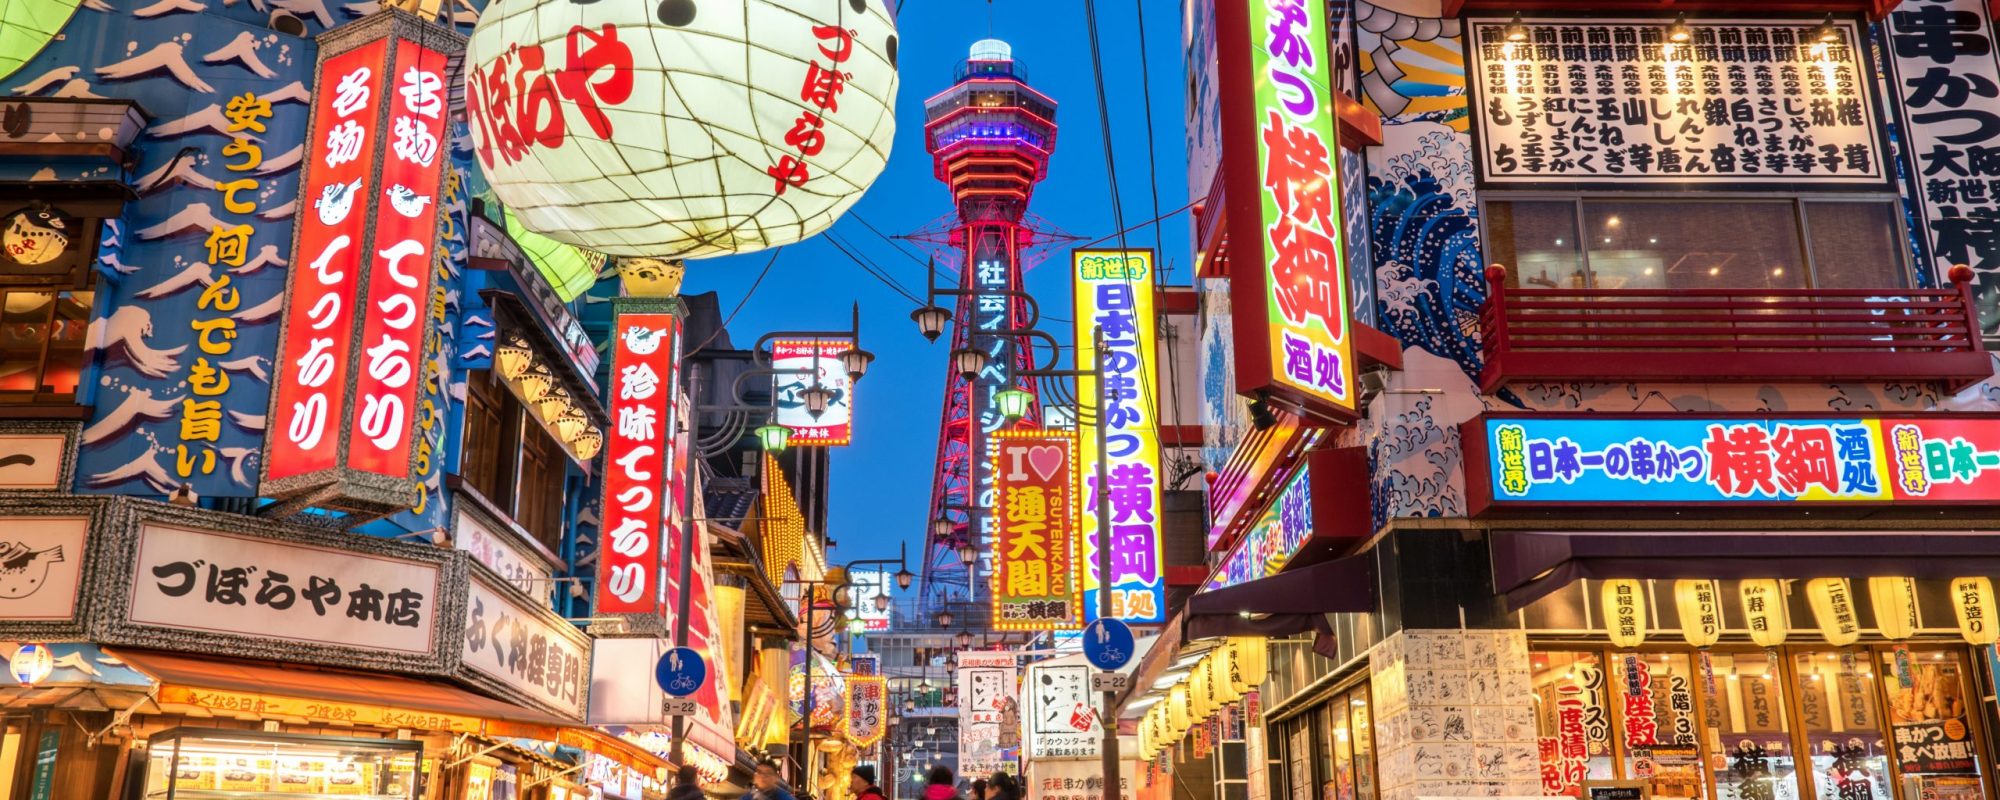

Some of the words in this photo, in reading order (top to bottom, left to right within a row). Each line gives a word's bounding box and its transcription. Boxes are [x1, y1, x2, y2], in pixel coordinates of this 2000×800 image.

[1481, 27, 1507, 61] 前頭
[1508, 27, 1534, 61] 頭
[1534, 27, 1560, 61] 前頭
[1560, 27, 1587, 62] 前頭
[1587, 27, 1614, 62] 前頭
[1614, 27, 1641, 62] 前頭
[1641, 27, 1667, 62] 前頭
[1667, 28, 1693, 62] 頭
[1693, 27, 1719, 62] 前頭
[1719, 27, 1746, 62] 前頭
[1745, 27, 1773, 62] 前頭
[1771, 27, 1799, 62] 前頭
[1568, 65, 1588, 94] 大地の幸
[1594, 65, 1615, 94] 大地の幸
[1621, 65, 1642, 94] 大地の幸
[1648, 65, 1667, 95] 大地の幸
[1675, 65, 1695, 95] 大地の幸
[1700, 65, 1722, 95] 大地の幸
[1727, 65, 1748, 95] 大地の幸
[1754, 65, 1775, 95] 大地の幸
[1780, 65, 1802, 95] 大地の幸
[1807, 65, 1828, 95] 大地の幸
[1834, 65, 1855, 95] 大地の幸
[1892, 5, 2000, 145] 串かつ
[326, 66, 371, 168] 名物
[392, 66, 443, 167] 名物
[768, 25, 858, 195] づぼらや
[1489, 97, 1517, 172] もち
[1516, 97, 1547, 172] うずら玉子
[1542, 97, 1575, 172] 紅しょうが
[1569, 99, 1598, 173] にんにく
[1596, 98, 1627, 173] 玉ねぎ
[1623, 98, 1654, 173] 山芋
[1650, 98, 1682, 172] しし唐
[1677, 98, 1710, 173] れんこん
[1702, 98, 1735, 172] 銀杏
[1731, 98, 1762, 172] 白ねぎ
[1758, 98, 1790, 172] さつま芋
[1784, 98, 1817, 172] じゃが芋
[1810, 98, 1843, 172] 茄子
[1837, 98, 1870, 173] 椎茸
[1920, 145, 2000, 177] 大阪
[1264, 112, 1343, 340] 横綱
[176, 92, 273, 477] 安うて何んでも旨い
[1081, 257, 1147, 279] 新世界
[288, 235, 351, 450] てっちり
[360, 240, 425, 450] てっちり
[1095, 284, 1140, 458] 日本一の串かつ
[1284, 334, 1343, 396] 酒処
[1006, 446, 1027, 481] I
[1500, 428, 1527, 492] 新世界
[1530, 441, 1701, 480] 日本一の串かつ
[1708, 425, 1839, 495] 横綱
[1836, 428, 1878, 494] 酒処
[1896, 428, 1927, 494] 新世界
[1926, 442, 2000, 479] 日本一
[608, 362, 660, 603] 珍味てっちり
[1006, 485, 1048, 598] 通天閣
[1050, 486, 1064, 596] TSUTENKAKU
[1088, 464, 1155, 585] 横綱
[151, 560, 424, 629] づぼらや本店
[1027, 601, 1066, 619] 横綱
[1616, 584, 1636, 636] 自慢の逸品
[1748, 597, 1768, 632] 寿司
[1963, 592, 1983, 633] お造り
[466, 595, 579, 705] ふぐ料理専門
[186, 691, 280, 714] ふぐなら日本一
[1094, 677, 1126, 688] 9-22
[306, 704, 357, 719] づぼらや
[381, 711, 464, 729] ふぐなら日本一
[663, 702, 695, 713] 9-22
[864, 684, 879, 726] 串かつ
[1582, 669, 1607, 739] ソースの
[1558, 685, 1588, 784] 二度漬け
[1895, 726, 1944, 745] 串かつ
[1042, 778, 1128, 790] 元祖串カツ専店
